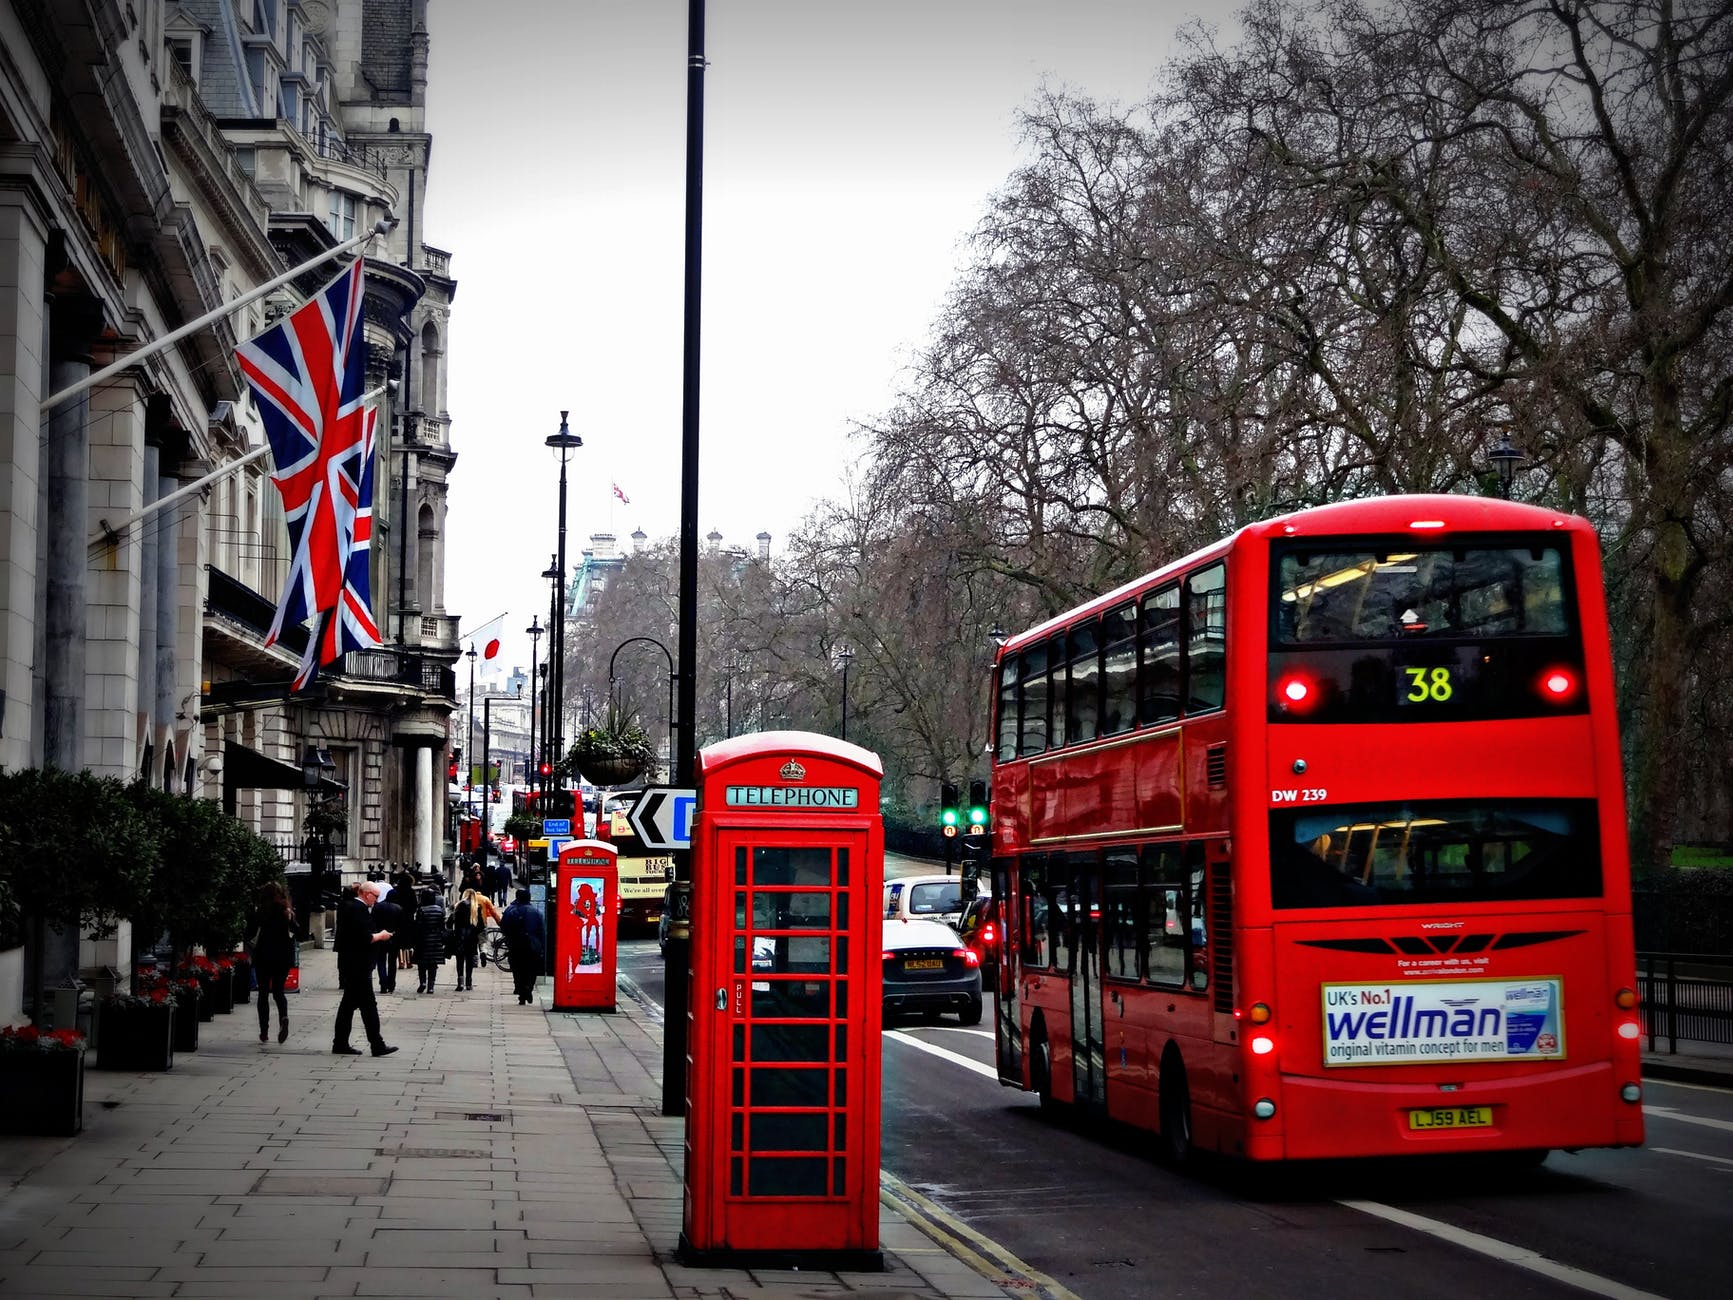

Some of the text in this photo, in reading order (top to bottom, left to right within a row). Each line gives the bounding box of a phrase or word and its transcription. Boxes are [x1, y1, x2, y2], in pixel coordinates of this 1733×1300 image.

[1405, 667, 1453, 702] 38
[731, 787, 853, 806] TELEPHONE
[1271, 788, 1328, 802] DW 239
[1397, 959, 1410, 967] For
[1327, 989, 1391, 1006] UK's No.1
[1327, 996, 1501, 1040] wellman
[1330, 1038, 1504, 1060] original vitamin concept for men
[1416, 1109, 1487, 1127] LJ59 AEL
